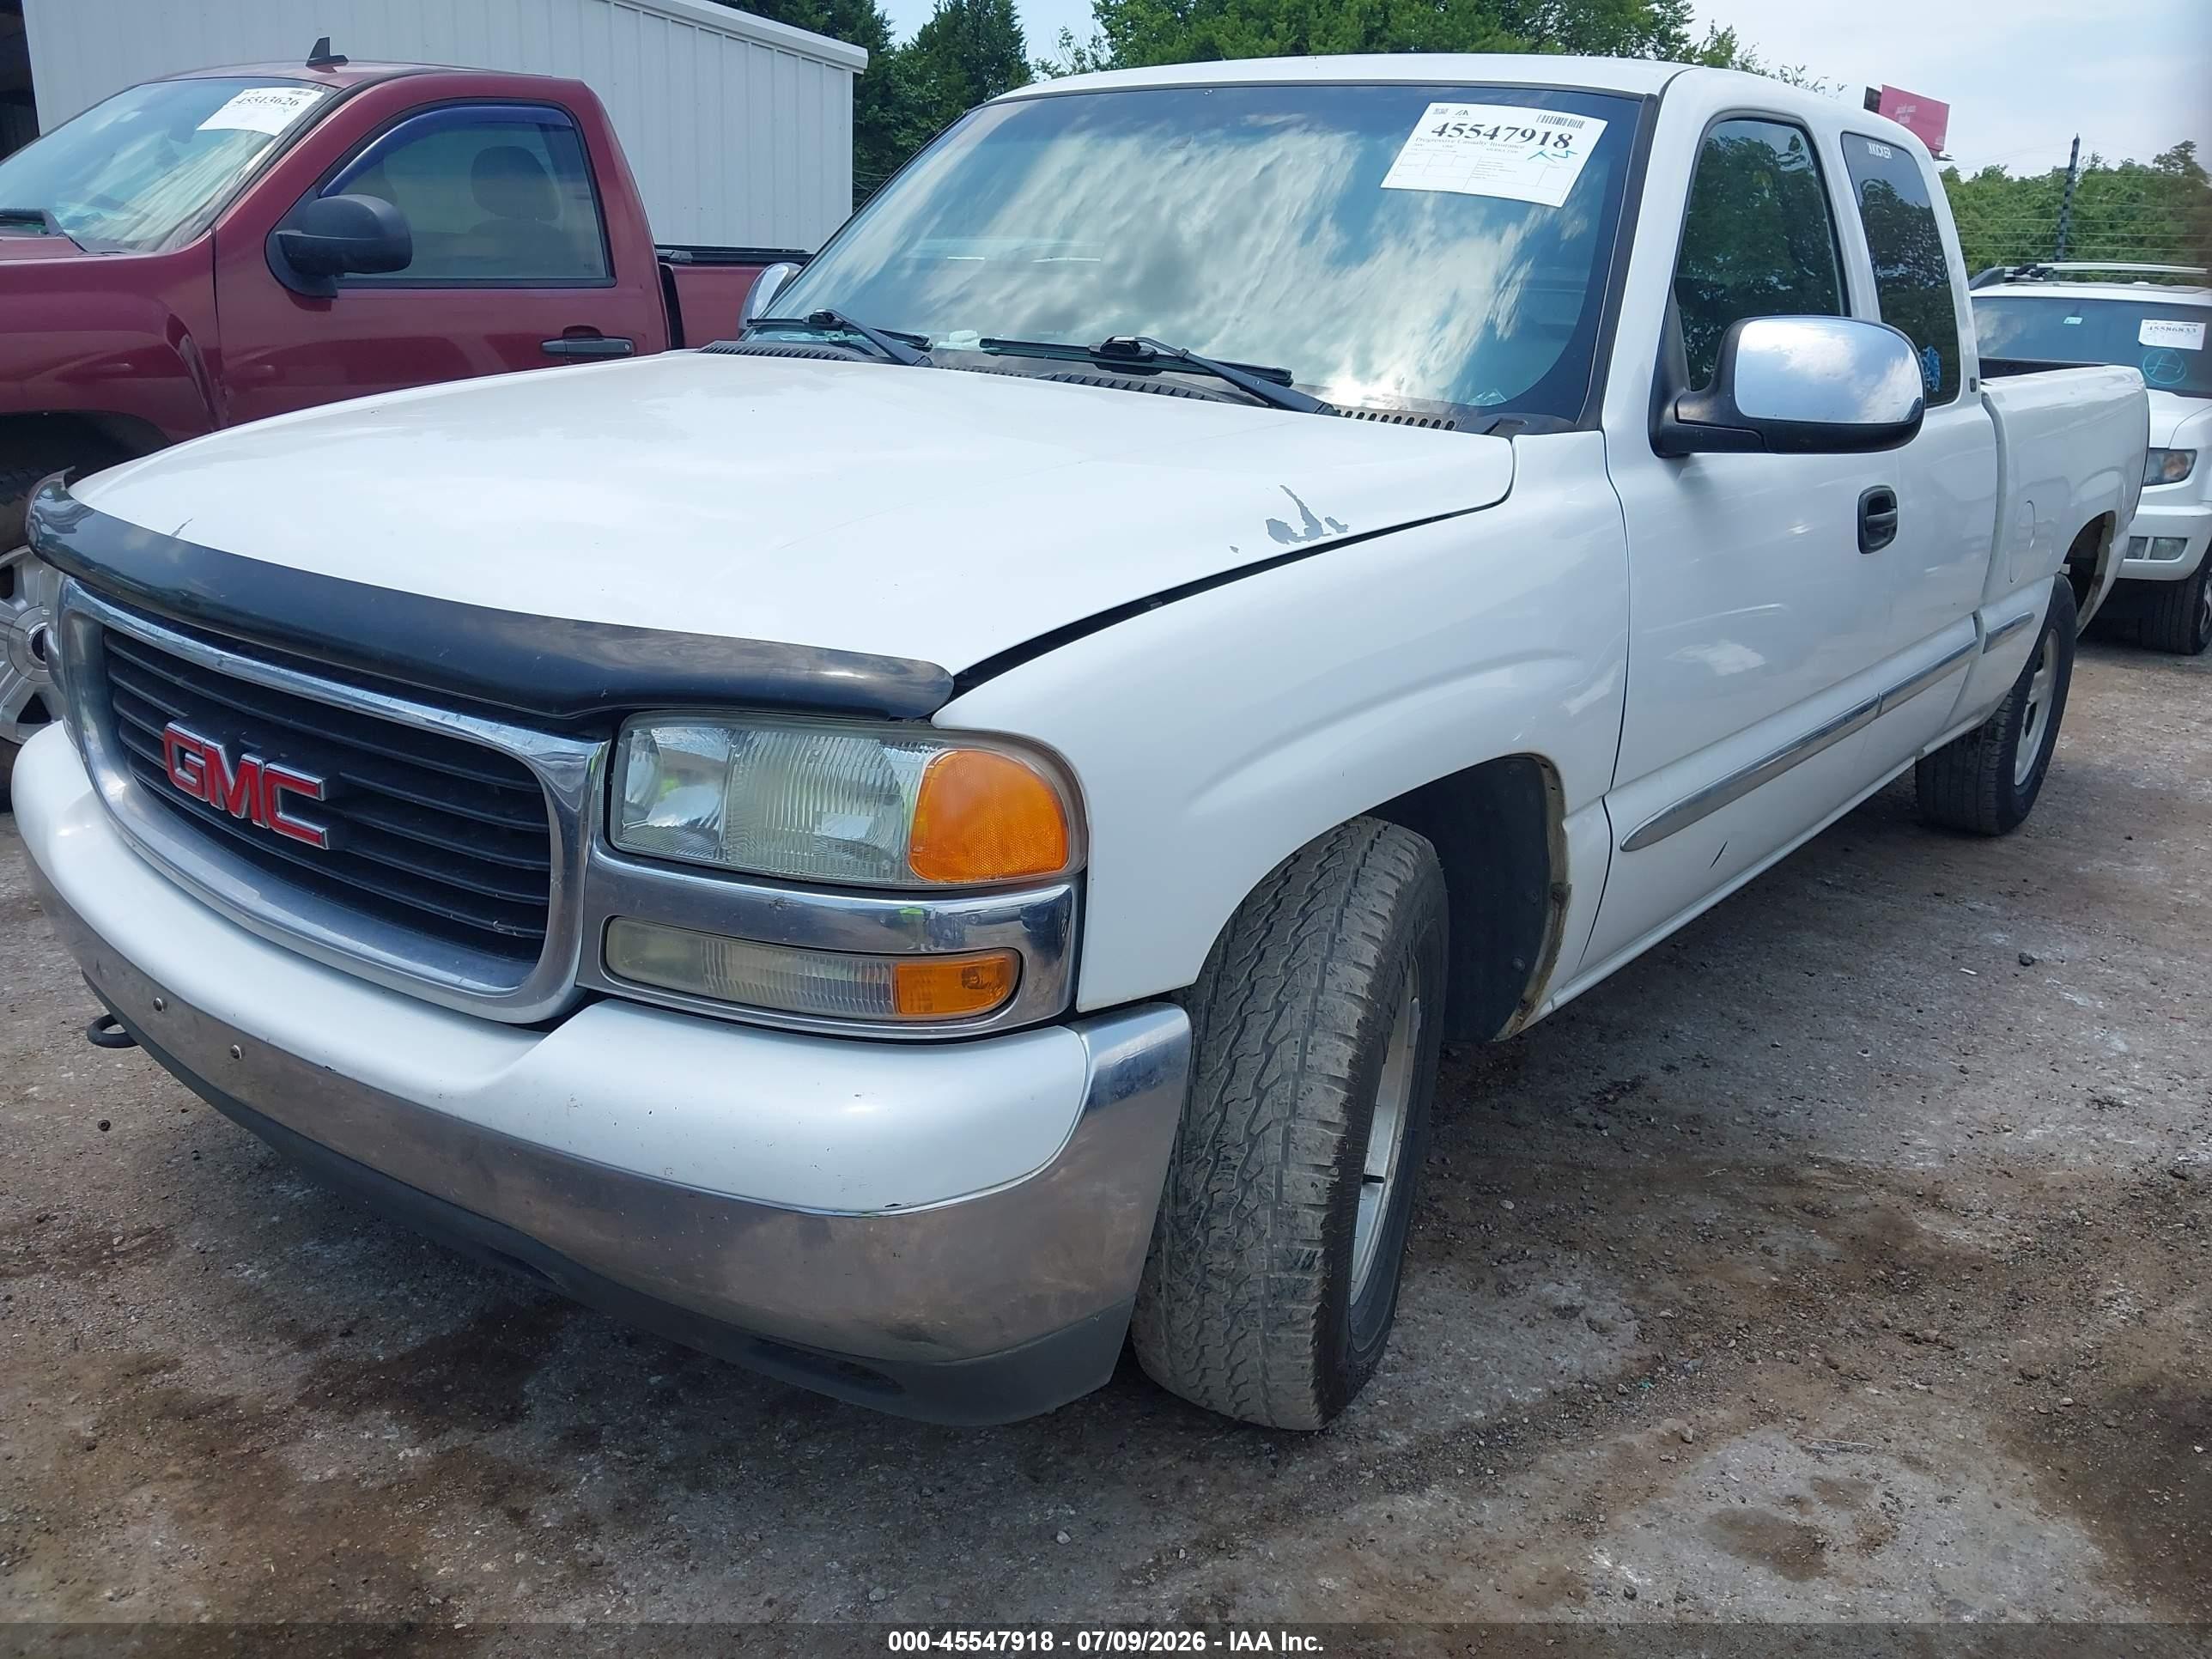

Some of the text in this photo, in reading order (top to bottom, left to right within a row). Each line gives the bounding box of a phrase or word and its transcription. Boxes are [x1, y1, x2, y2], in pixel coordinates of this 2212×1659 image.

[1431, 121, 1573, 150] 45547918
[1490, 141, 1525, 149] Insurance
[163, 721, 330, 850] GMC
